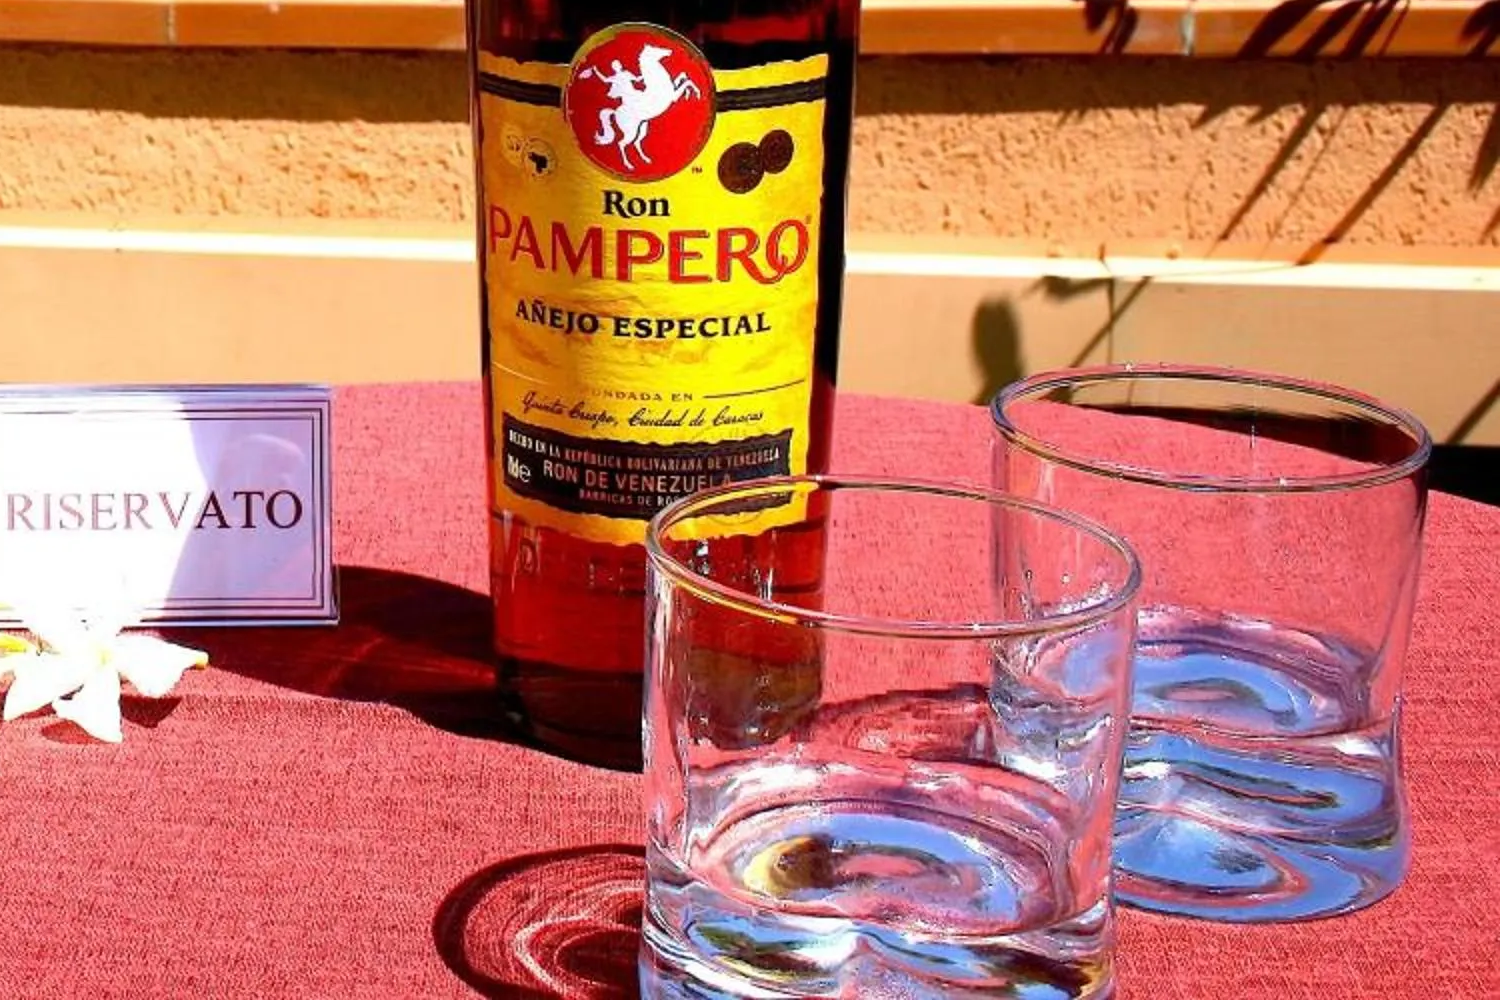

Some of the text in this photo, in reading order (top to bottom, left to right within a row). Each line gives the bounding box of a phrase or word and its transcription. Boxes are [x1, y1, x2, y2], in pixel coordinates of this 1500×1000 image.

[602, 190, 671, 219] Ron
[489, 203, 810, 285] PAMPERO
[515, 298, 772, 339] AÑEJO ESPECIAL
[581, 387, 693, 402] UNDADA EN
[689, 408, 706, 427] de
[542, 459, 578, 484] RON
[585, 469, 610, 489] DE
[707, 455, 722, 470] DE
[6, 489, 304, 531] RISERVATO
[637, 495, 653, 507] DE
